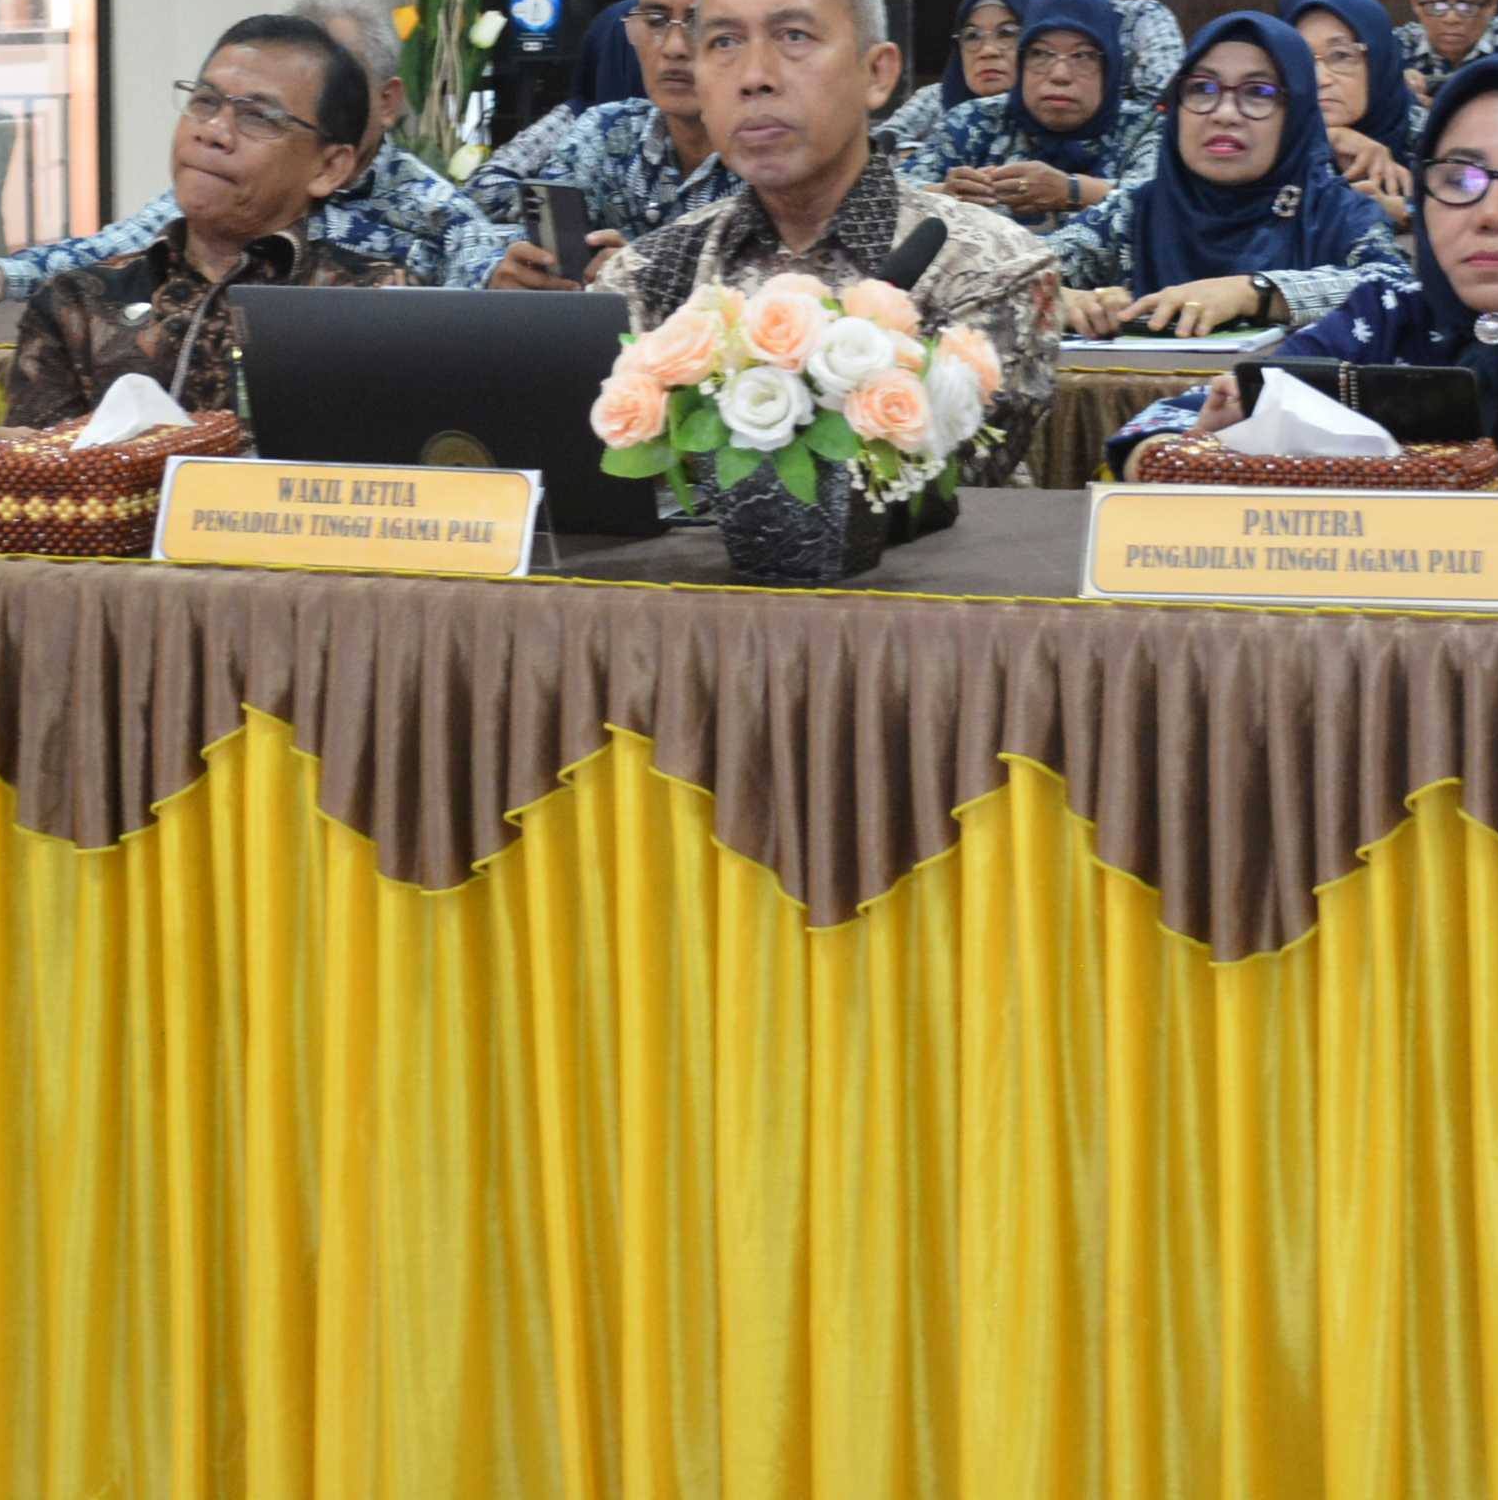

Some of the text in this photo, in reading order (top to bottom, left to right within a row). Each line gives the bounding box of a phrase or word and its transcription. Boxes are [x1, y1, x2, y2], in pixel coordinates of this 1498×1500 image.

[277, 477, 417, 507] WAKIL KETUA
[191, 509, 303, 536] PENGADILAN
[308, 514, 374, 538] TINGGI
[378, 517, 440, 541] AGAMA
[1241, 508, 1365, 537] PANITERA
[1124, 544, 1485, 574] PENGADILAN TINGGI AGAMA PALU
